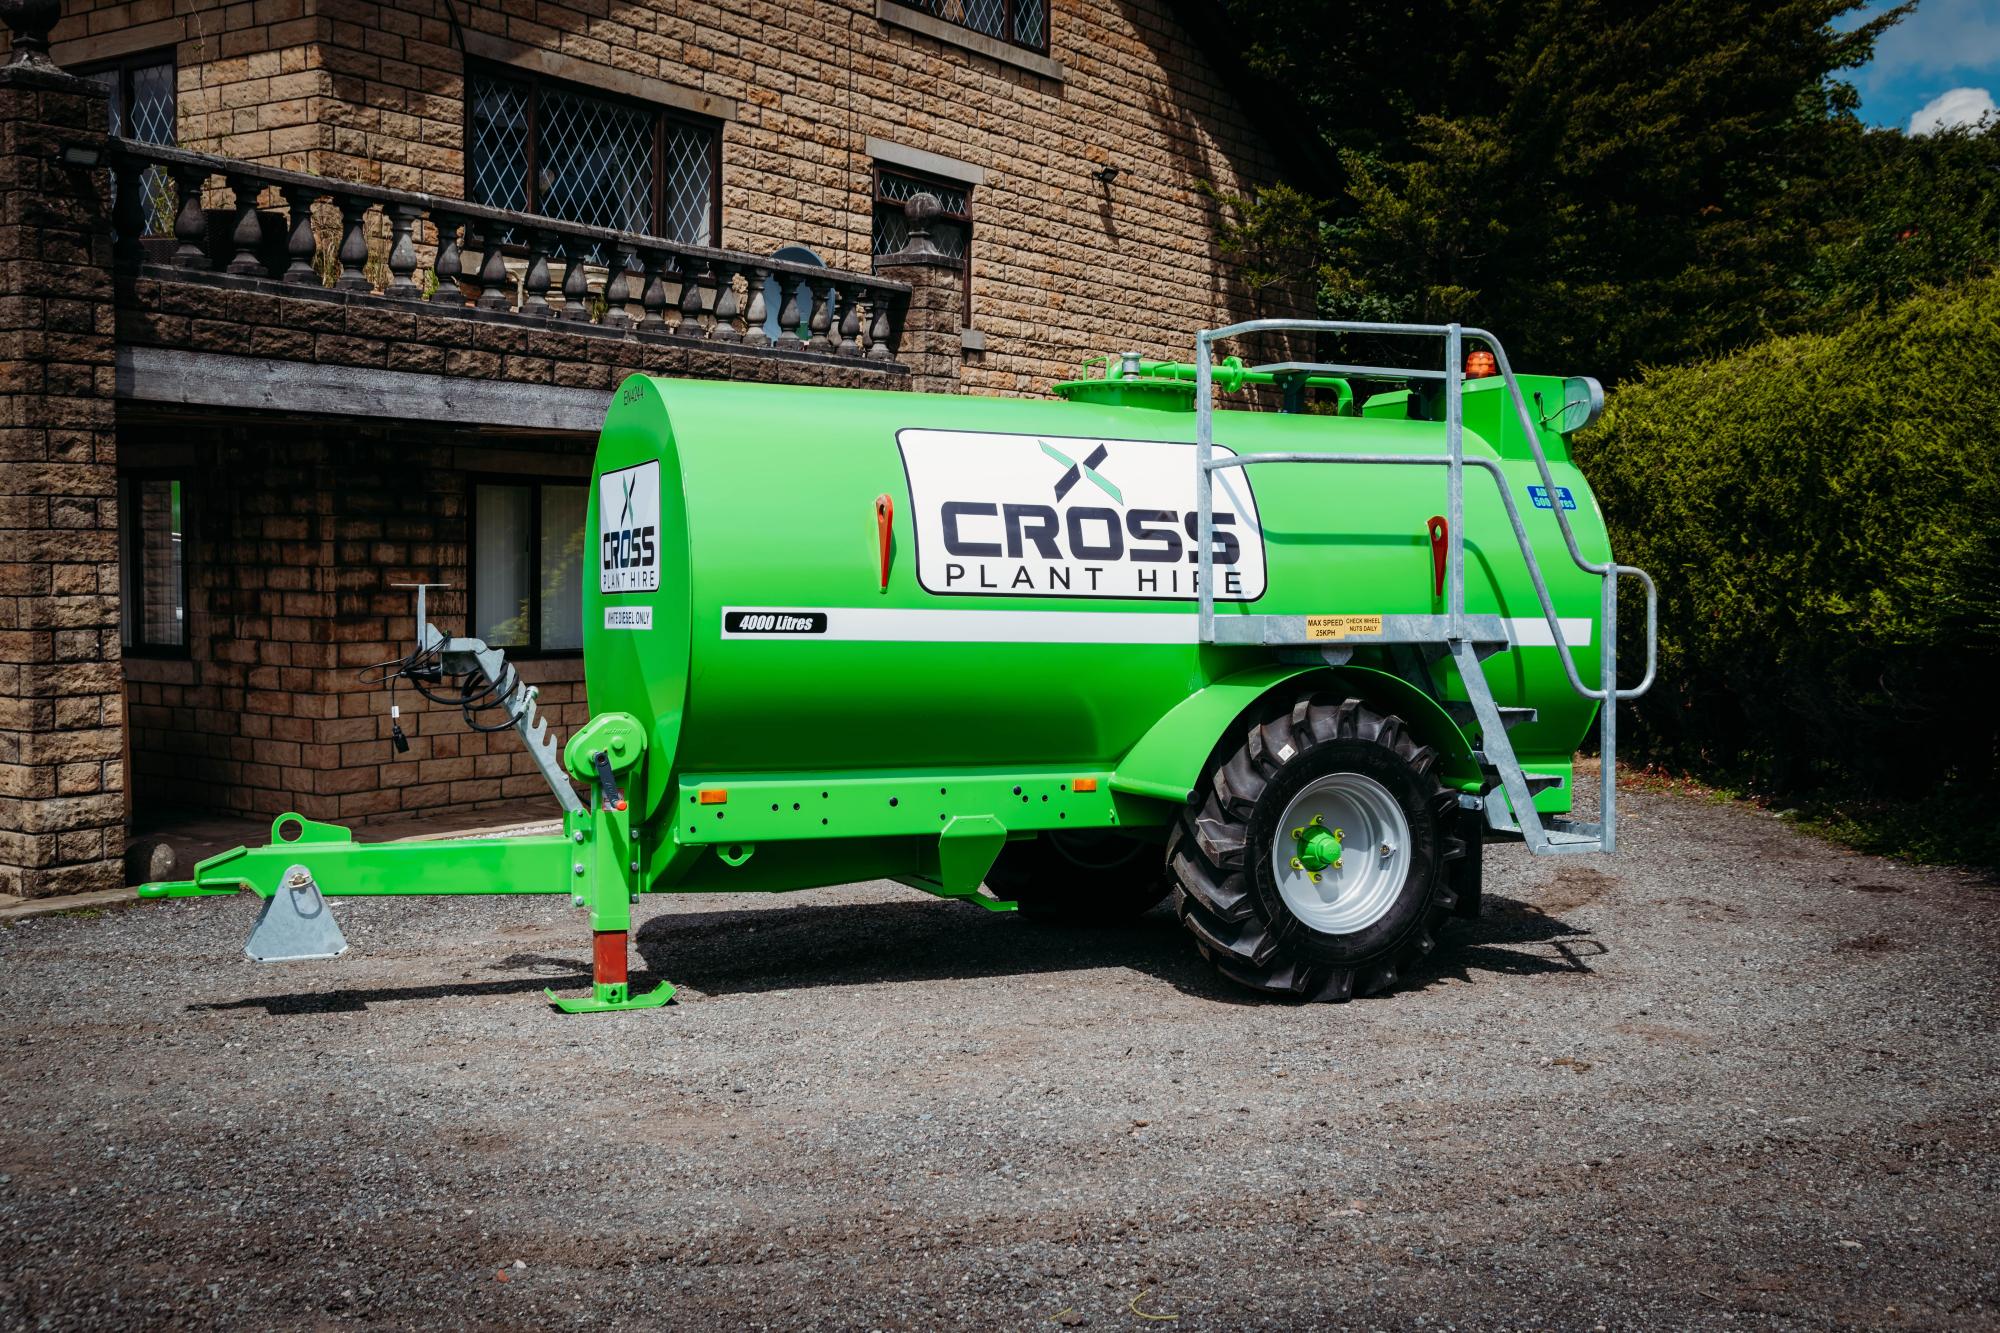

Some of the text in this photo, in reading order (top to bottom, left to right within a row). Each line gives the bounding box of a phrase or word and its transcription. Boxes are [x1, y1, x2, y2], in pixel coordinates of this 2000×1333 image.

[941, 501, 1241, 565] CROSS
[603, 526, 655, 570] CROSS
[603, 571, 655, 590] PLANT HIRE
[946, 563, 1104, 591] PLANT
[636, 611, 650, 624] ONLY
[739, 614, 813, 631] 4000 Litres
